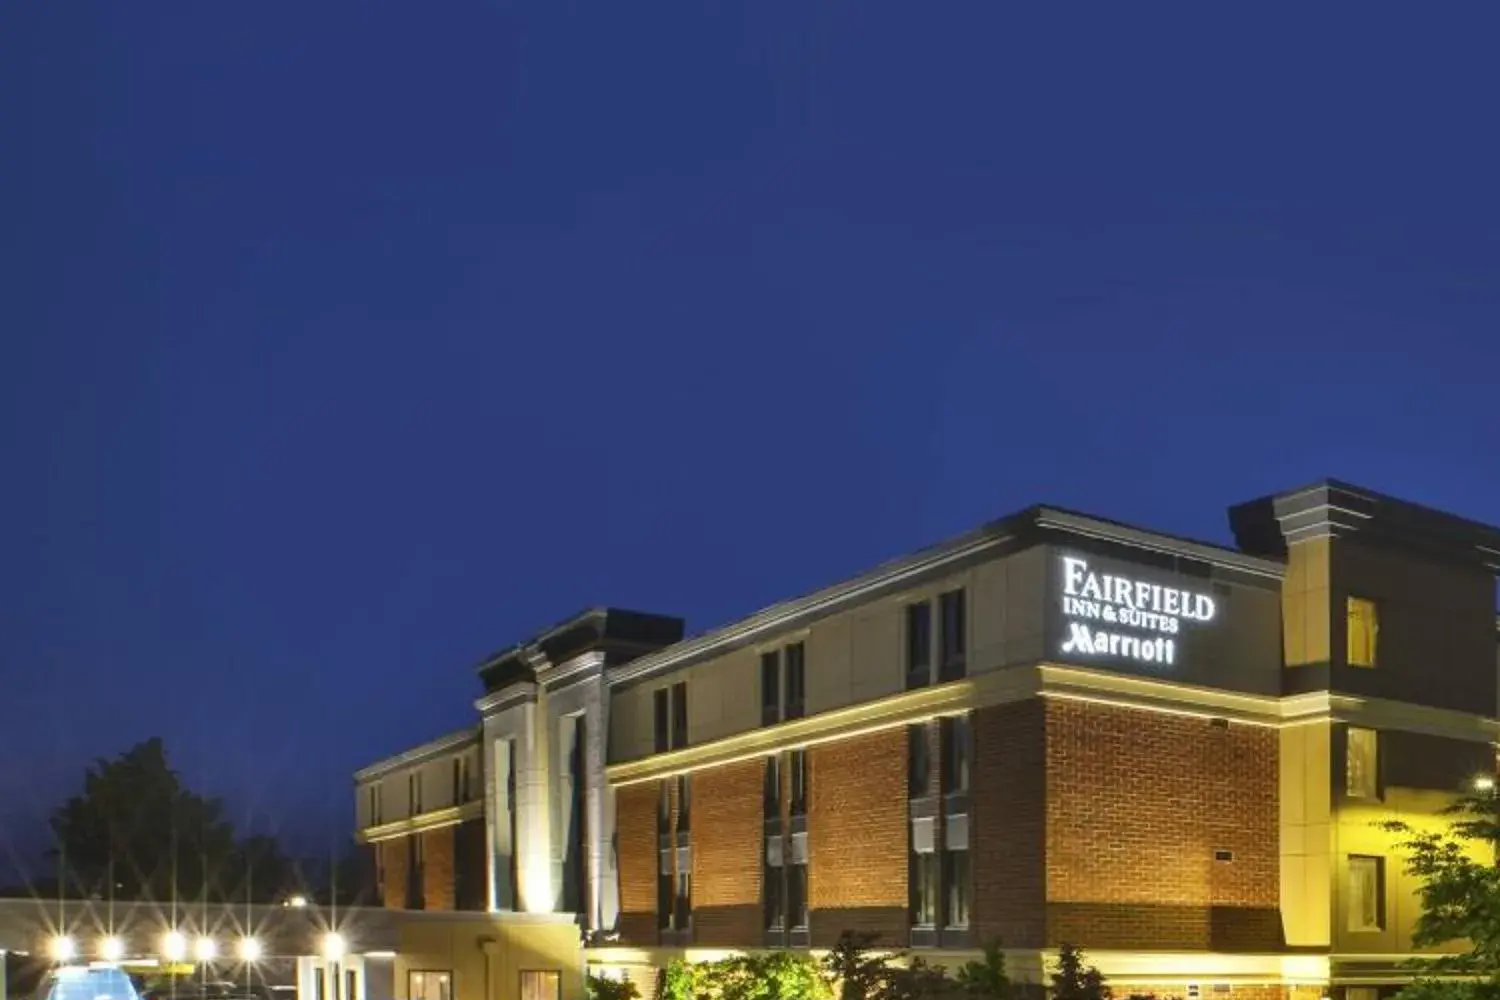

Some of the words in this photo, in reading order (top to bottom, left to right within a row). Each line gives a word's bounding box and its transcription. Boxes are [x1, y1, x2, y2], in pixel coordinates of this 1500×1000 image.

[1063, 556, 1216, 621] FAIRFIELD
[1063, 596, 1101, 619] INN
[1102, 604, 1118, 623] &
[1119, 608, 1179, 634] SUITES
[1062, 621, 1175, 665] Marriott
